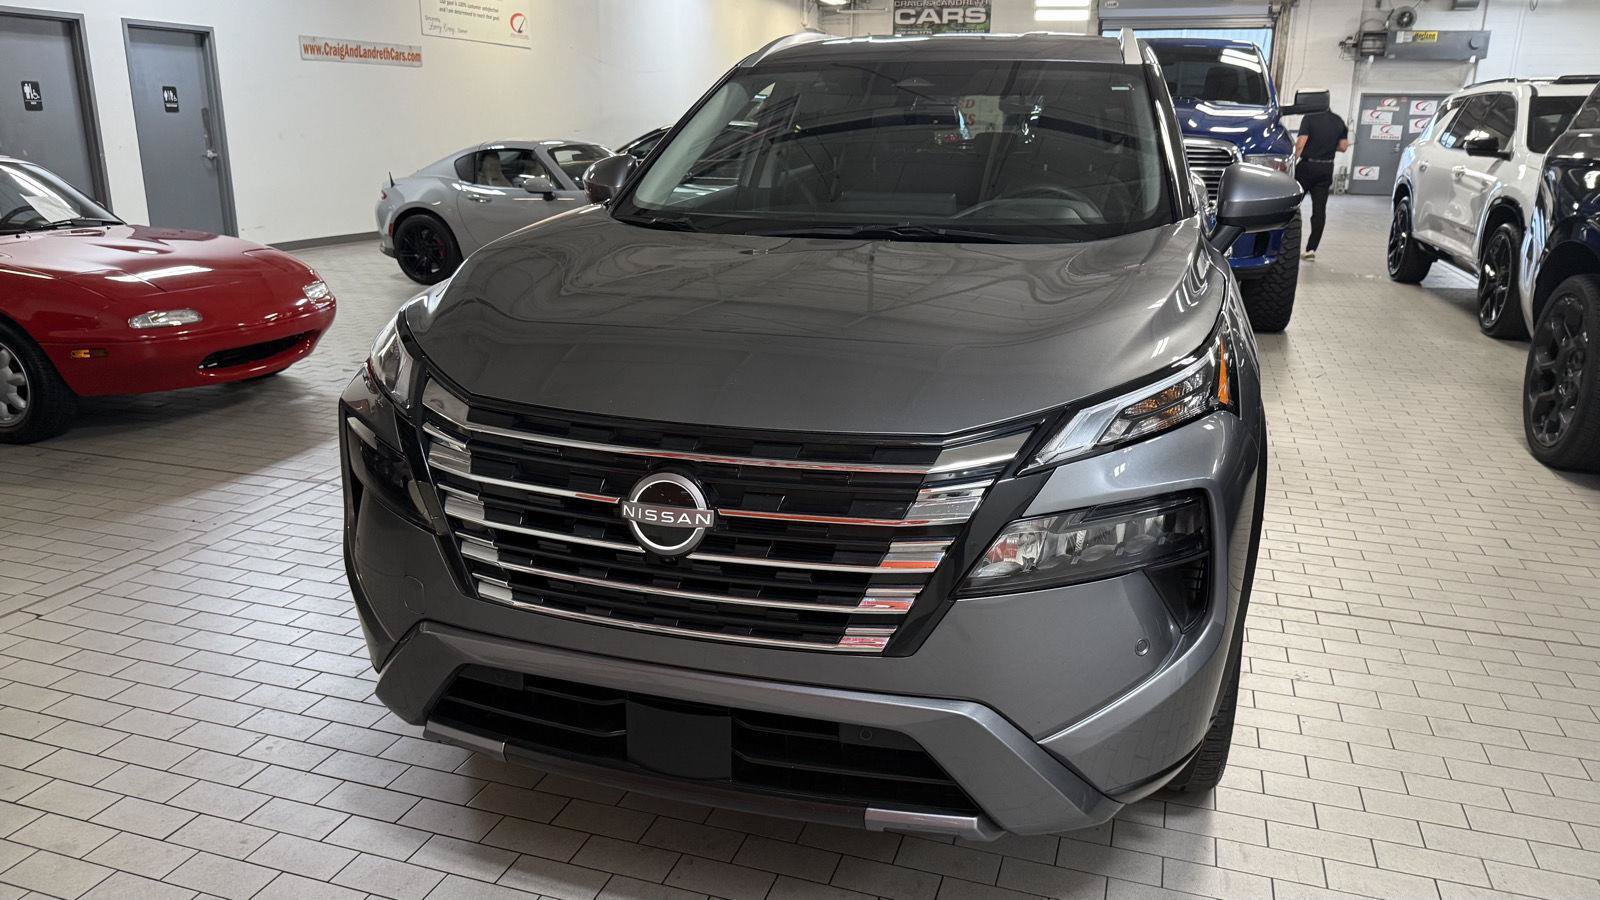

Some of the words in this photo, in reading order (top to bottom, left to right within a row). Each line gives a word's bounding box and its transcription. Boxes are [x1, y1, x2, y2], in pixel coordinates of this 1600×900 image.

[895, 8, 987, 25] CARS
[303, 41, 422, 62] www.CraigAndLandrethCars.com
[623, 505, 710, 525] NISSAN
